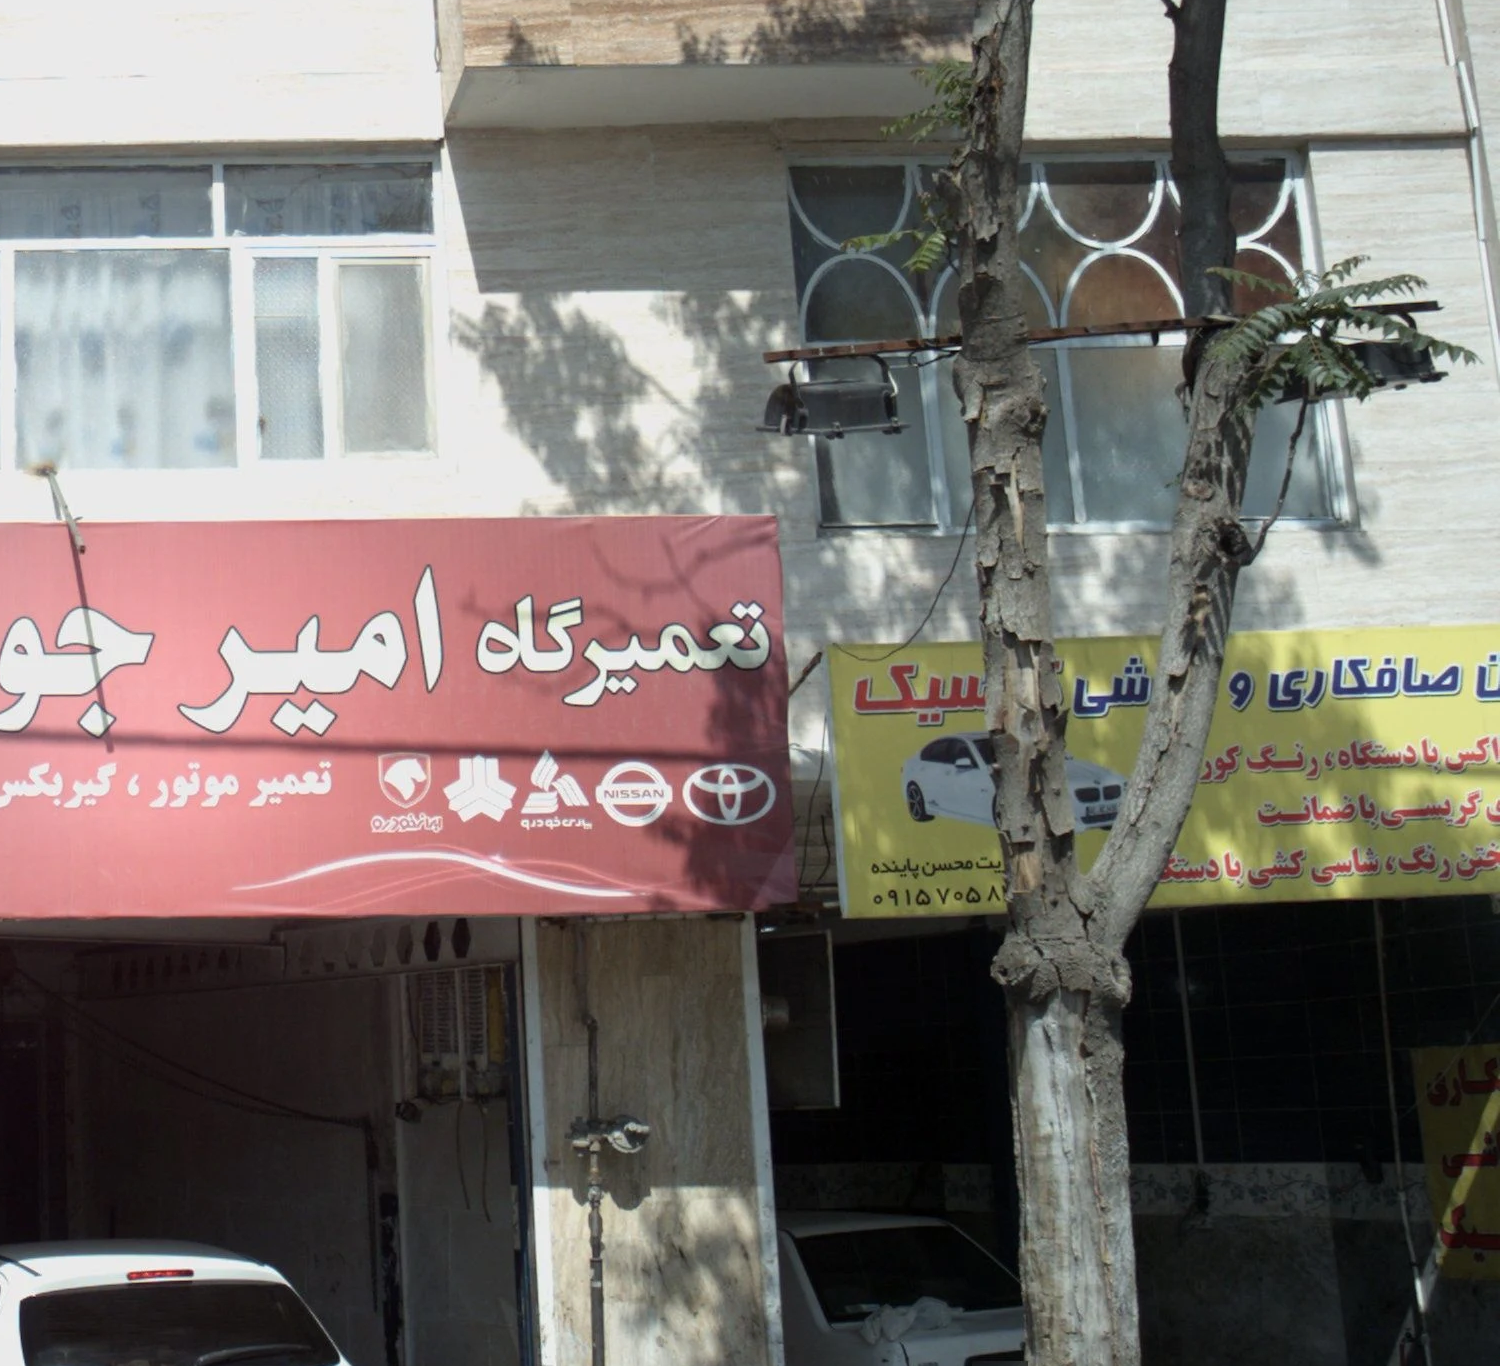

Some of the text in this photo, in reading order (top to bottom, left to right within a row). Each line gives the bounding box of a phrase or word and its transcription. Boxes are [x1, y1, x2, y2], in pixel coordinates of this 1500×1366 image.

[178, 564, 443, 736] امیر
[476, 595, 771, 706] تعمیرگاه
[1228, 670, 1255, 710] و
[1268, 657, 1461, 712] صافکاری
[1200, 745, 1240, 782] کور
[1247, 742, 1320, 778] رنگ
[1421, 739, 1440, 772] با
[1446, 736, 1500, 772] اکس
[149, 762, 240, 809] موتور
[248, 761, 333, 807] تعمیر
[603, 788, 665, 800] NISSAN
[1257, 794, 1356, 825] ضمانت
[1357, 794, 1377, 826] با
[870, 858, 920, 879] پاینده
[921, 860, 973, 877] محسن
[1160, 856, 1221, 882] دستگ
[1223, 851, 1243, 887] با
[1247, 848, 1306, 885] کشی
[1311, 847, 1380, 884] شاسی
[1456, 842, 1500, 879] ختن
[873, 887, 932, 906] ۰۹۱۵
[936, 886, 982, 905] ۷۰۵
